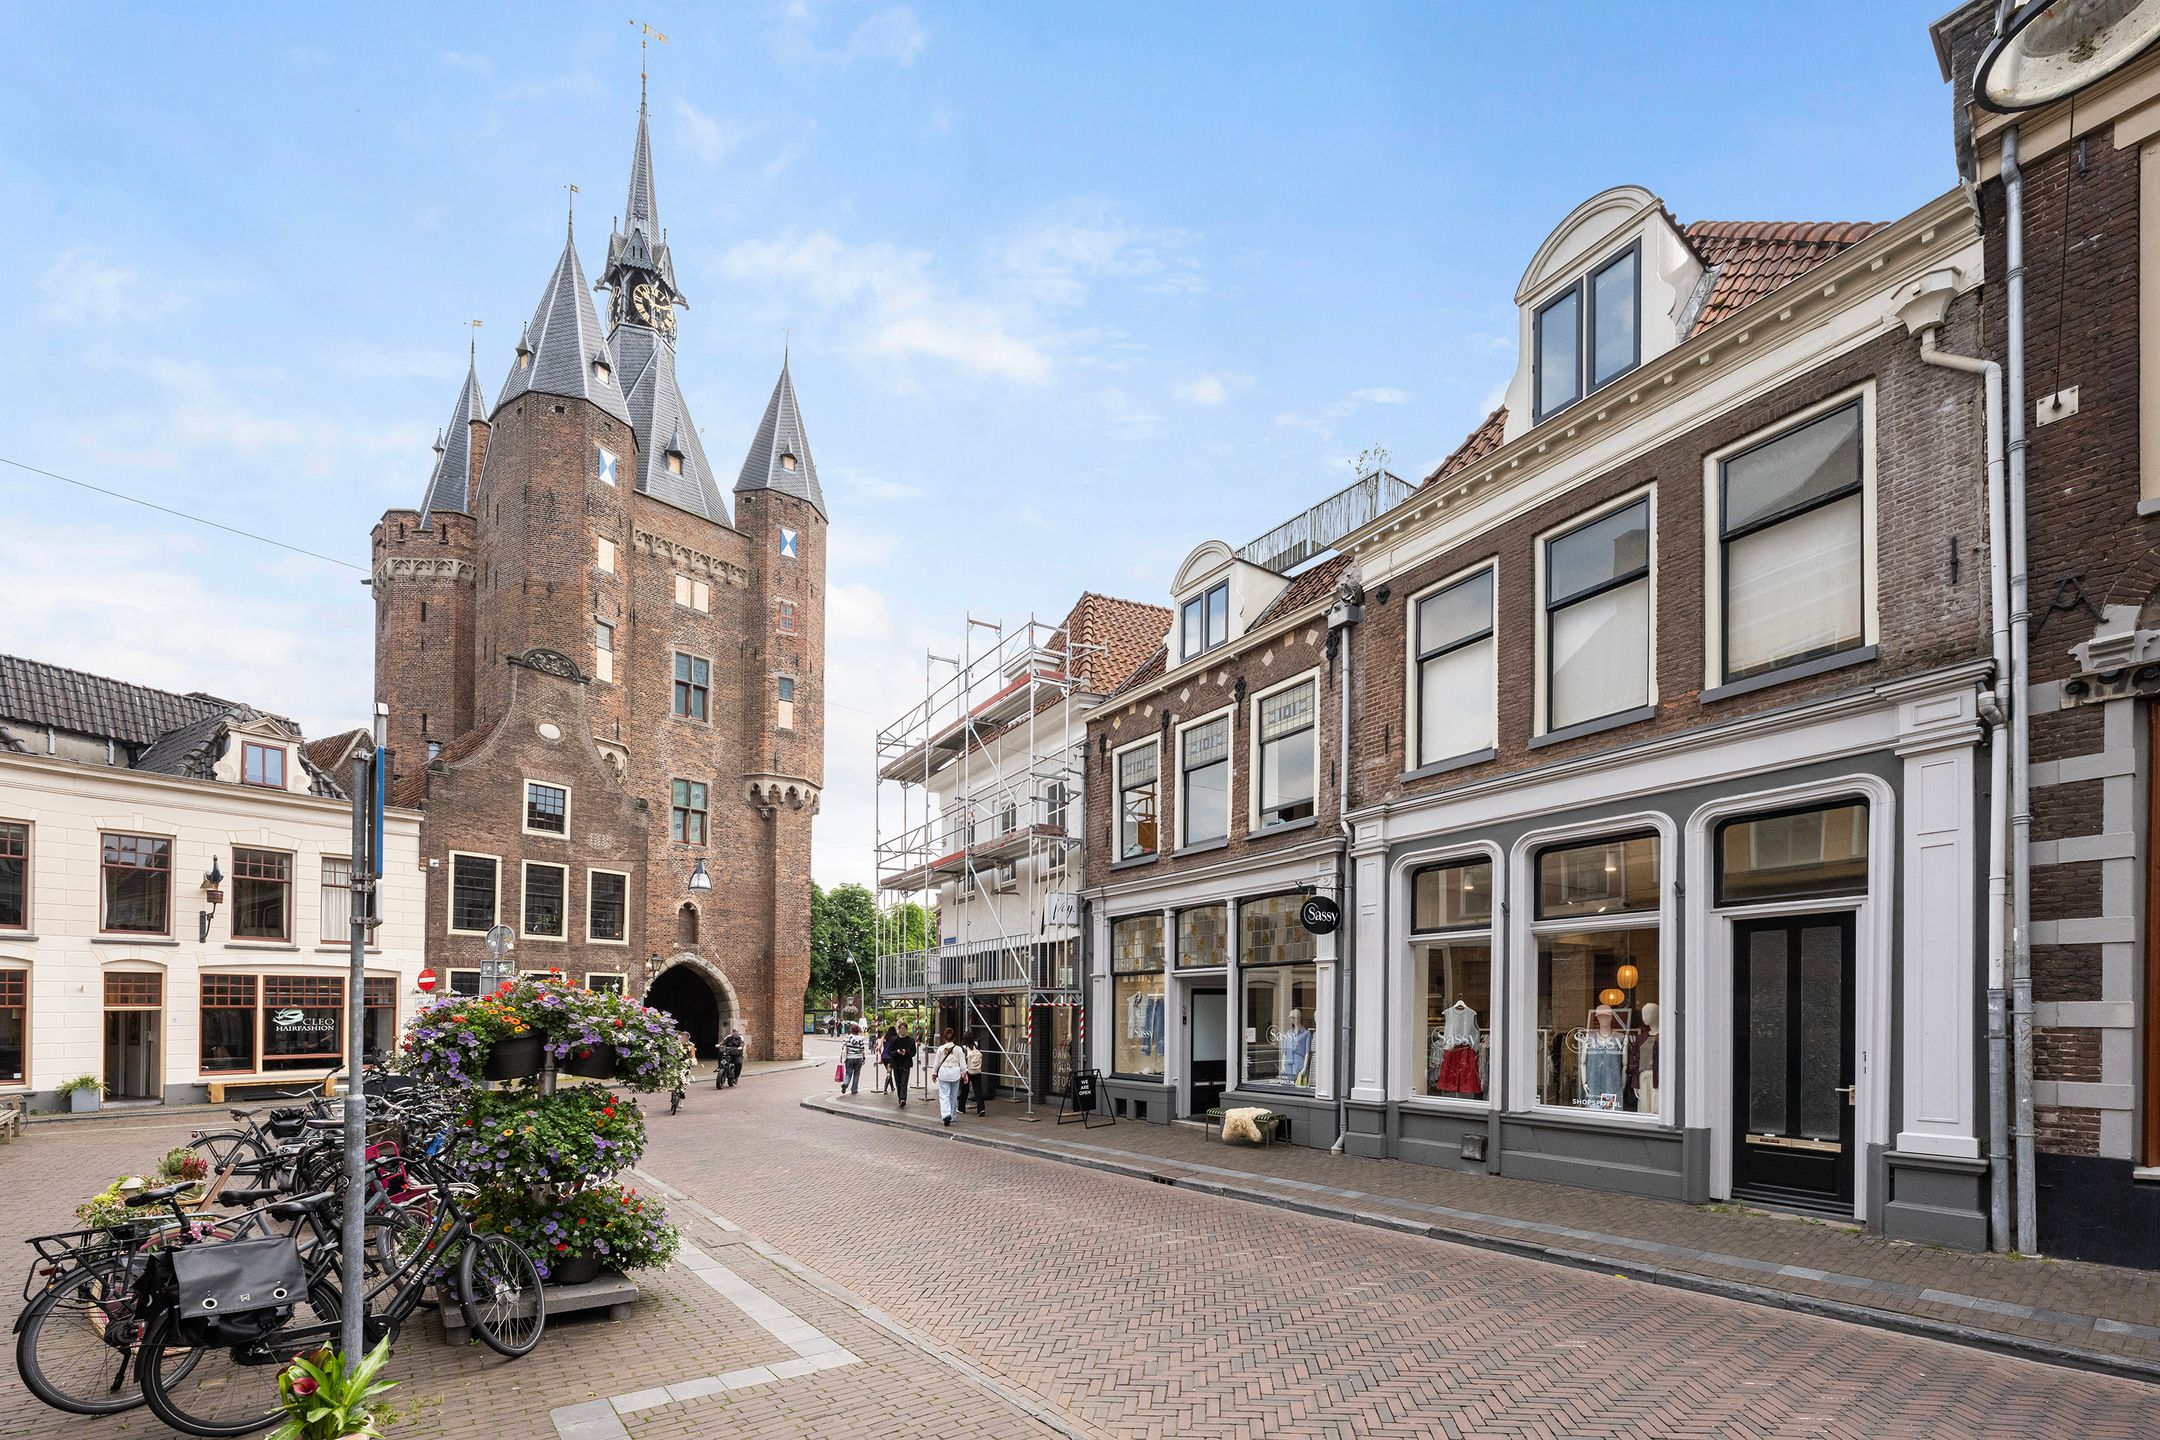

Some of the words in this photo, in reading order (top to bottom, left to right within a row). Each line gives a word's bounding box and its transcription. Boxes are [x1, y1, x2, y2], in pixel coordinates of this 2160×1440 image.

[1304, 902, 1339, 926] Sassy
[1431, 1025, 1479, 1050] Sassy
[1565, 1027, 1628, 1054] Sassy
